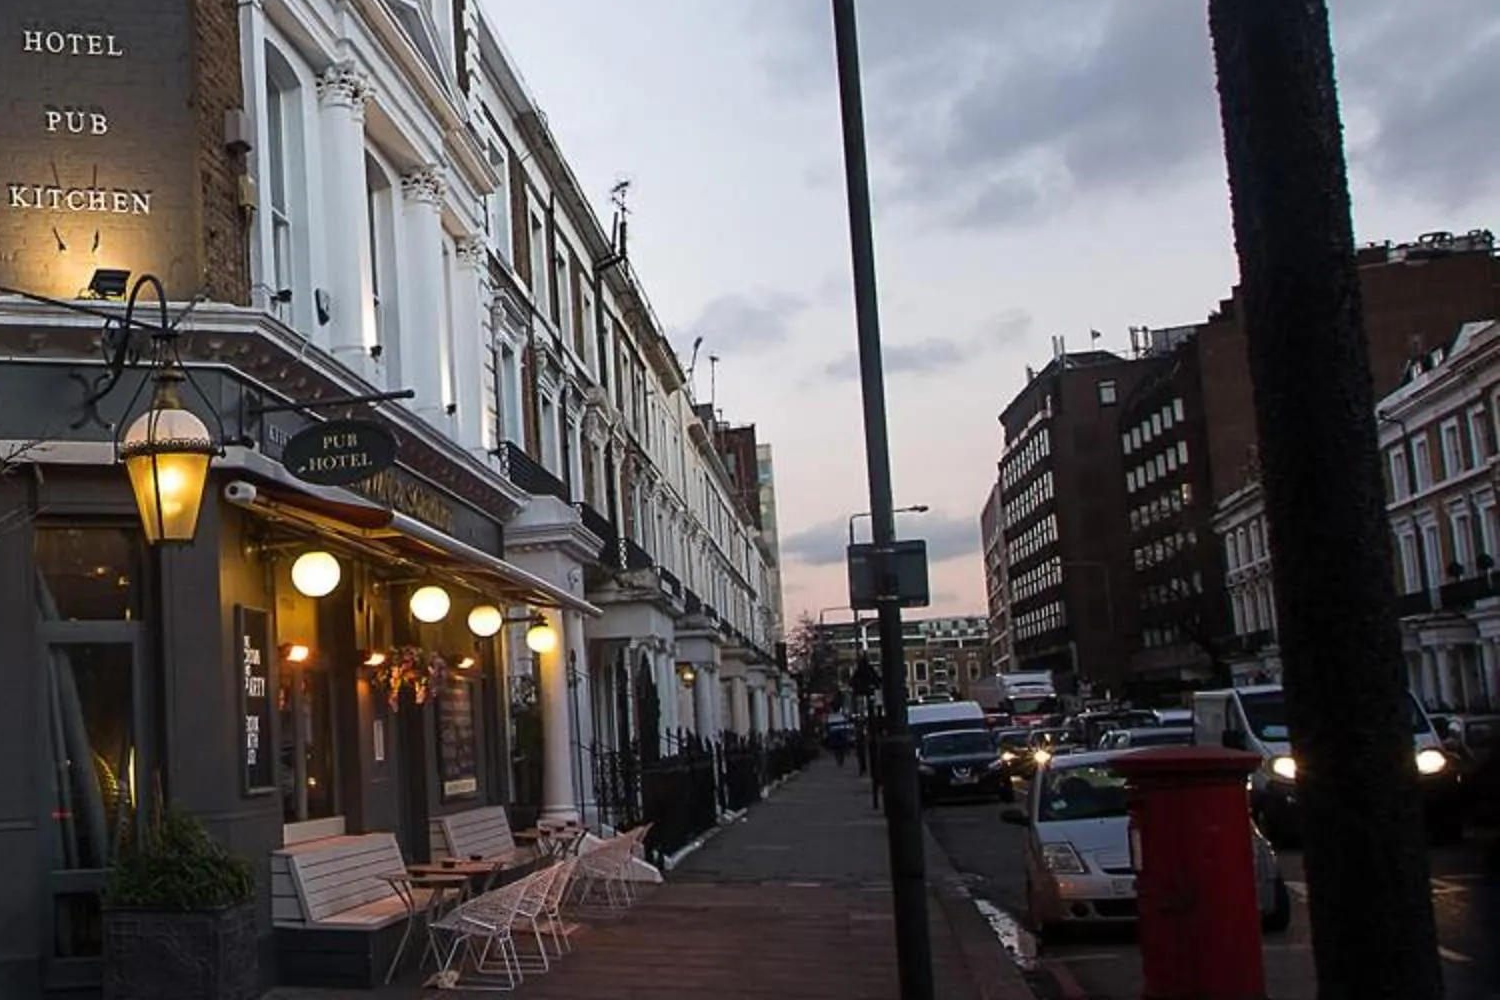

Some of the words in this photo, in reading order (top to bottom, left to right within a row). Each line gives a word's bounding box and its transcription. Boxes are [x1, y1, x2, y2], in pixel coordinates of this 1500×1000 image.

[23, 30, 124, 57] HOTEL
[46, 110, 108, 135] PUB
[8, 185, 152, 215] KITCHEN
[322, 433, 359, 450] PUB
[308, 452, 373, 473] HOTEL
